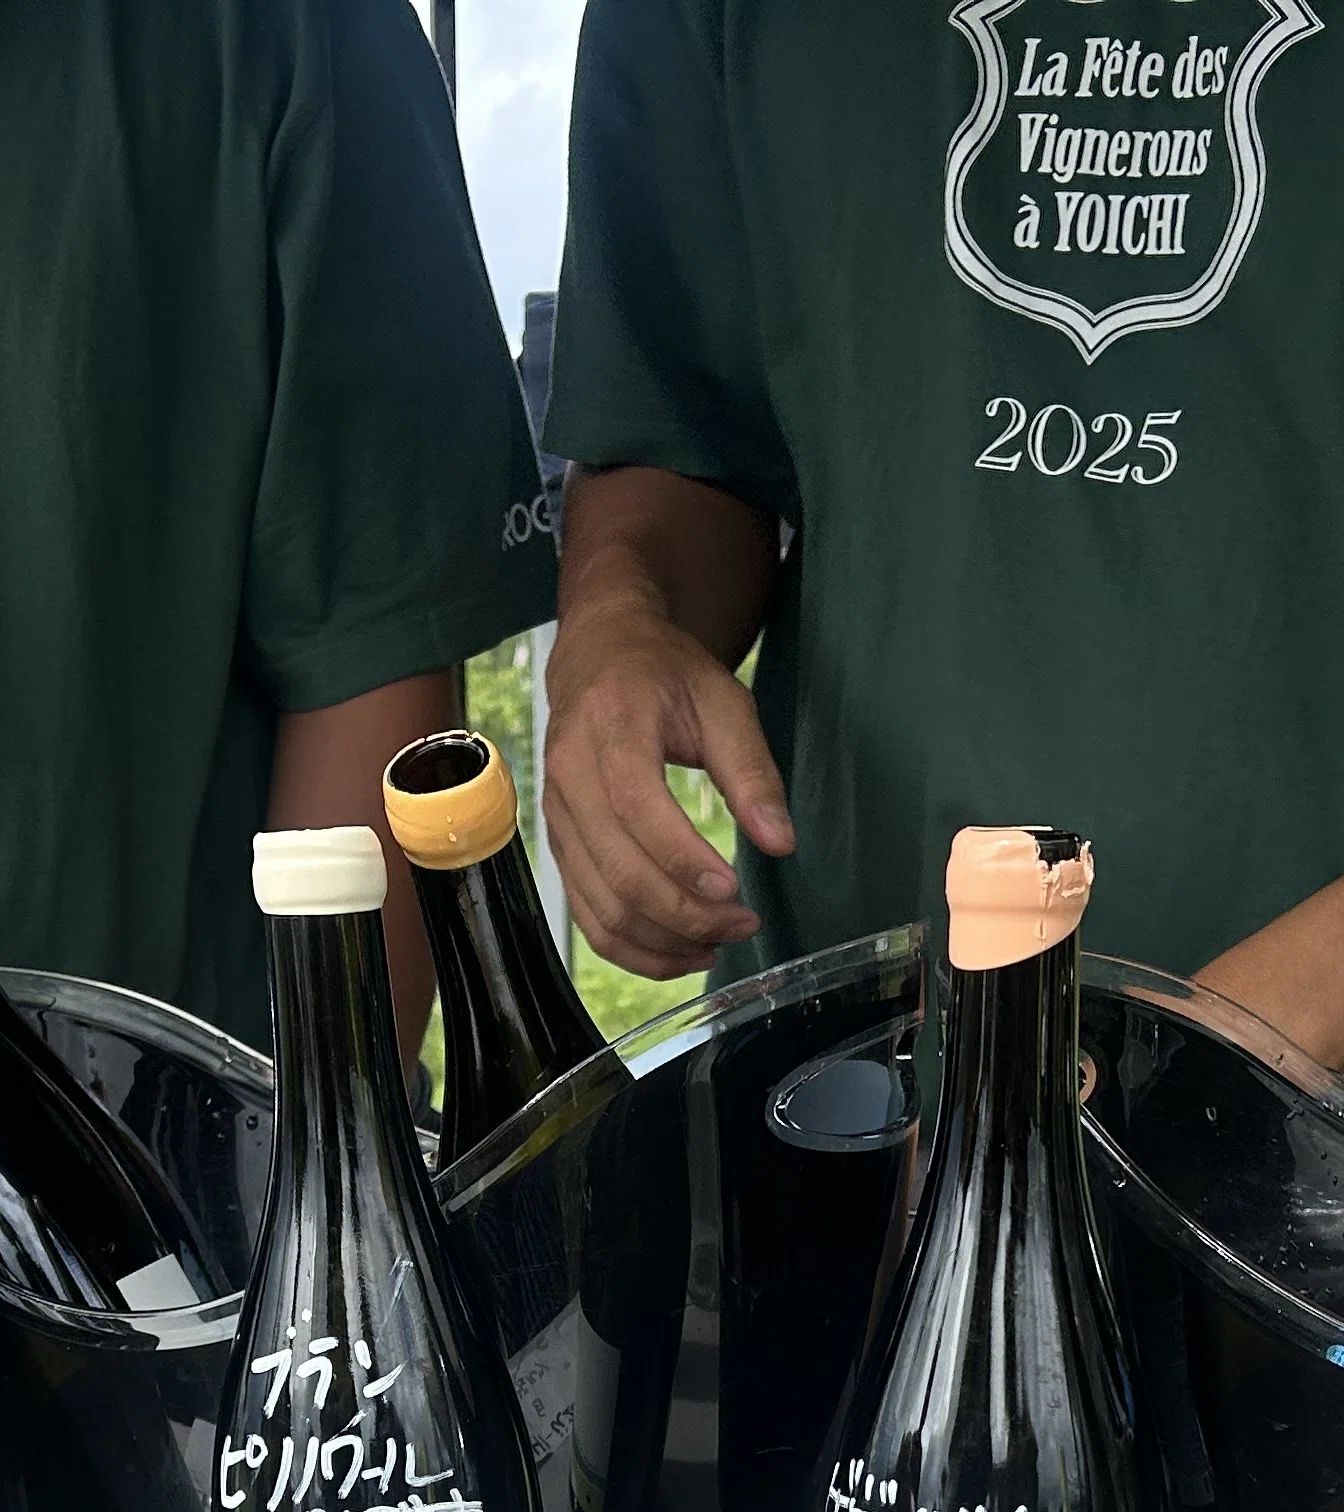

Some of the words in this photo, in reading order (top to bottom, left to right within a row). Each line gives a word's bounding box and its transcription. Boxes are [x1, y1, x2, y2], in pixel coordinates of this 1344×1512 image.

[1014, 37, 1068, 97] La
[1075, 36, 1164, 99] Fête
[1172, 35, 1228, 99] des
[1017, 113, 1212, 183] Vignerons
[1013, 194, 1043, 249] à
[1053, 191, 1190, 255] YOICHI
[974, 397, 1182, 485] 2025
